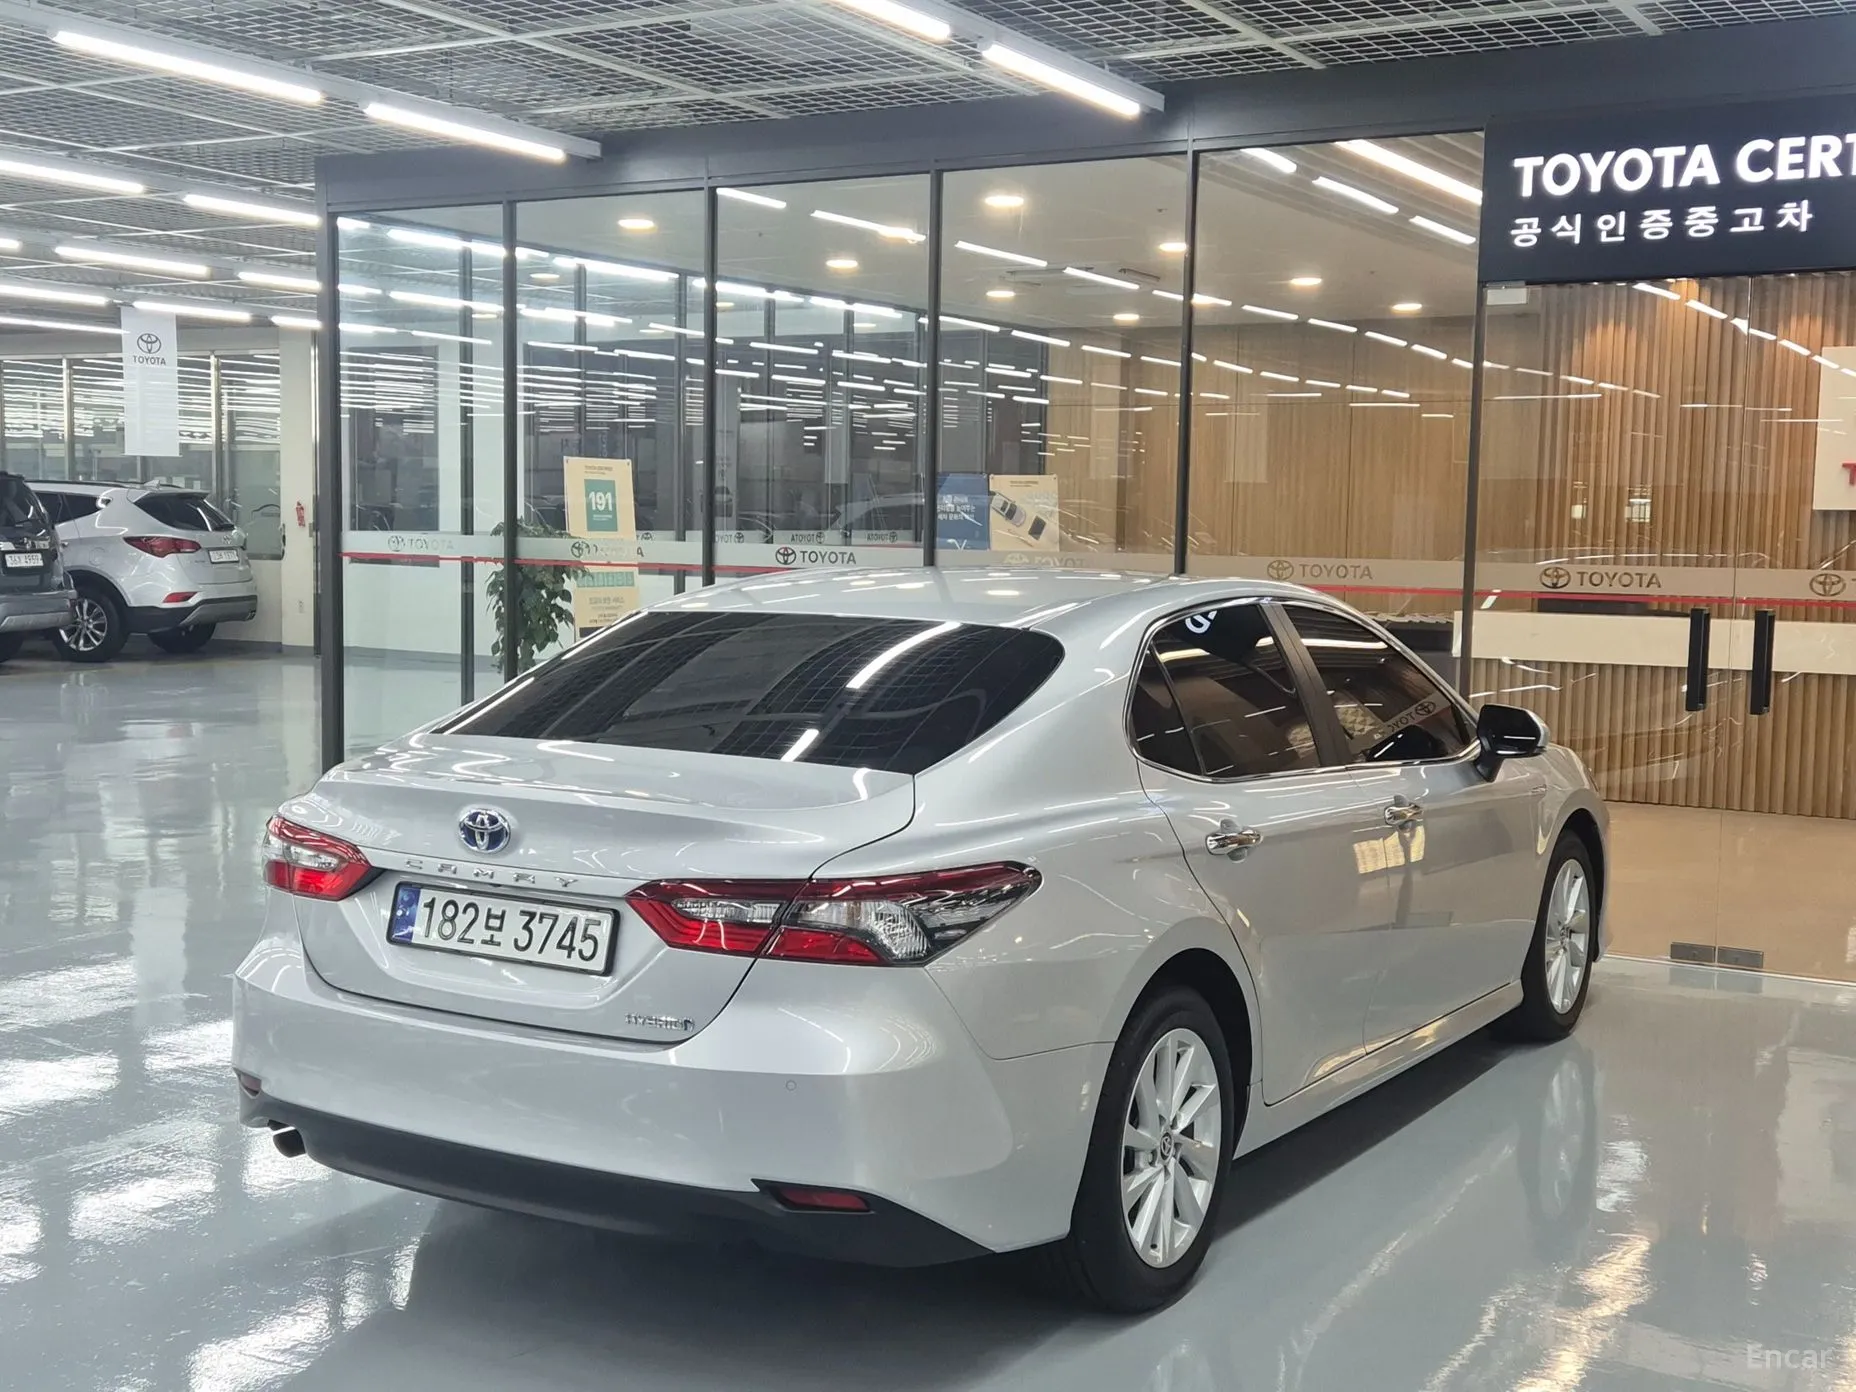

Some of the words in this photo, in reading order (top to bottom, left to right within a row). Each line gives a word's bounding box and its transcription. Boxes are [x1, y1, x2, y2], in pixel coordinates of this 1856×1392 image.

[1513, 143, 1720, 198] TOYOTA
[132, 355, 167, 366] TOYOTA
[589, 491, 613, 511] 191
[800, 549, 857, 565] TOYOTA
[1299, 563, 1373, 580] TOYOTA
[1577, 571, 1662, 589] TOYOTA
[404, 859, 579, 888] CAMRY
[421, 895, 505, 948] 182보
[513, 909, 602, 963] 3745
